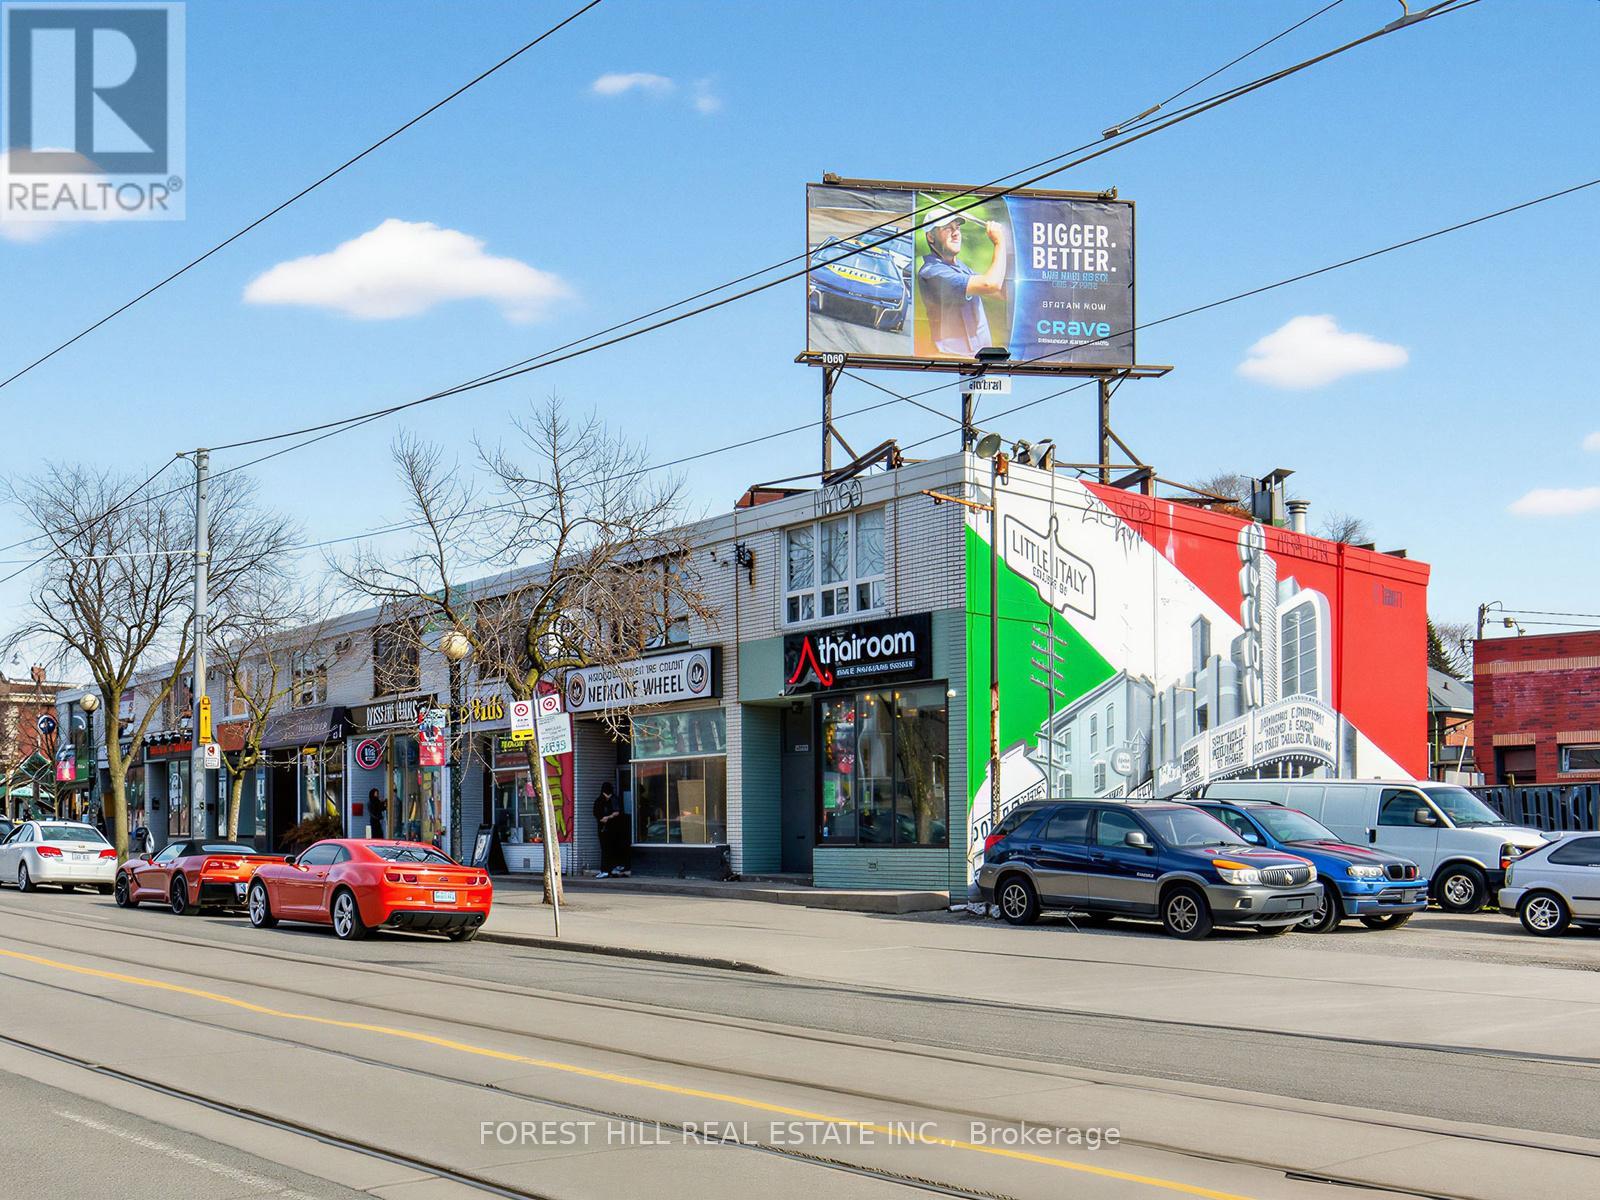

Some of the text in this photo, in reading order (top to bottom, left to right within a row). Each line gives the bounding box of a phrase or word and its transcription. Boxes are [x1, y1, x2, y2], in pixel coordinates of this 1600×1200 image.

[1032, 222, 1117, 248] BIGGER.
[1032, 246, 1117, 273] BETTER.
[1012, 529, 1049, 573] LITTLE
[1055, 556, 1088, 595] ITALY
[818, 630, 916, 665] thairoom
[643, 674, 684, 696] WHEEL
